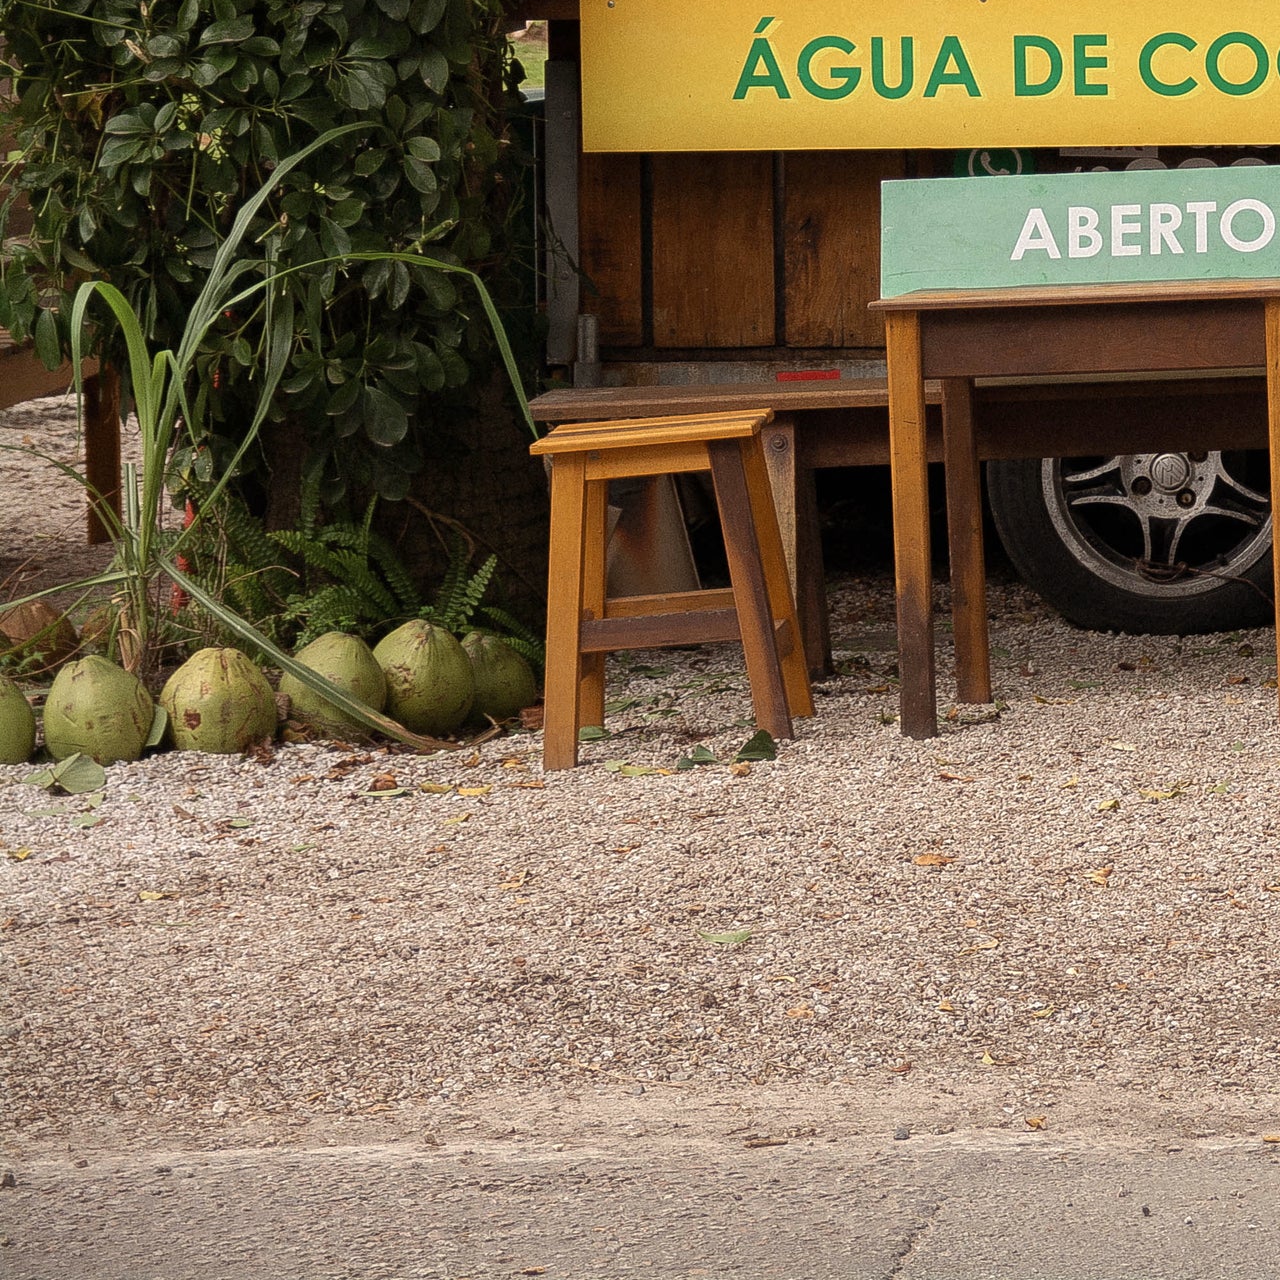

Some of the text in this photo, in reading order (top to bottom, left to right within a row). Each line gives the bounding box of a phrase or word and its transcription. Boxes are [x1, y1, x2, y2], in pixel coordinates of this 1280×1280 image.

[732, 17, 983, 101] ÁGUA
[1014, 34, 1108, 96] DE
[1010, 198, 1276, 261] ABERTO
